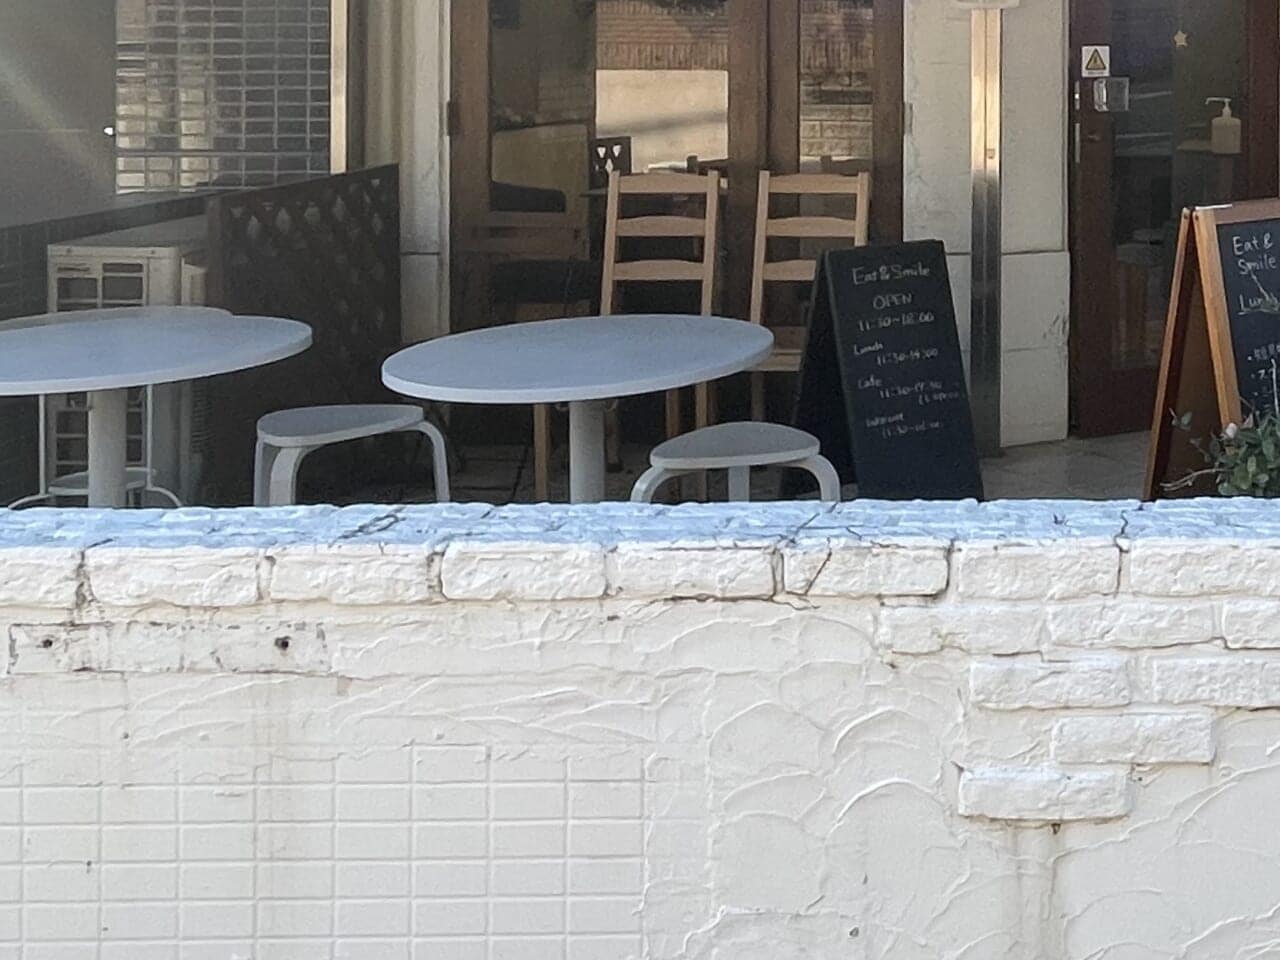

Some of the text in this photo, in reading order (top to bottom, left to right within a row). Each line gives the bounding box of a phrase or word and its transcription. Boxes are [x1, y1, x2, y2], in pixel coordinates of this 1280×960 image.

[1232, 235, 1260, 255] Eat
[1238, 253, 1277, 275] Smile
[873, 293, 912, 310] OPEN
